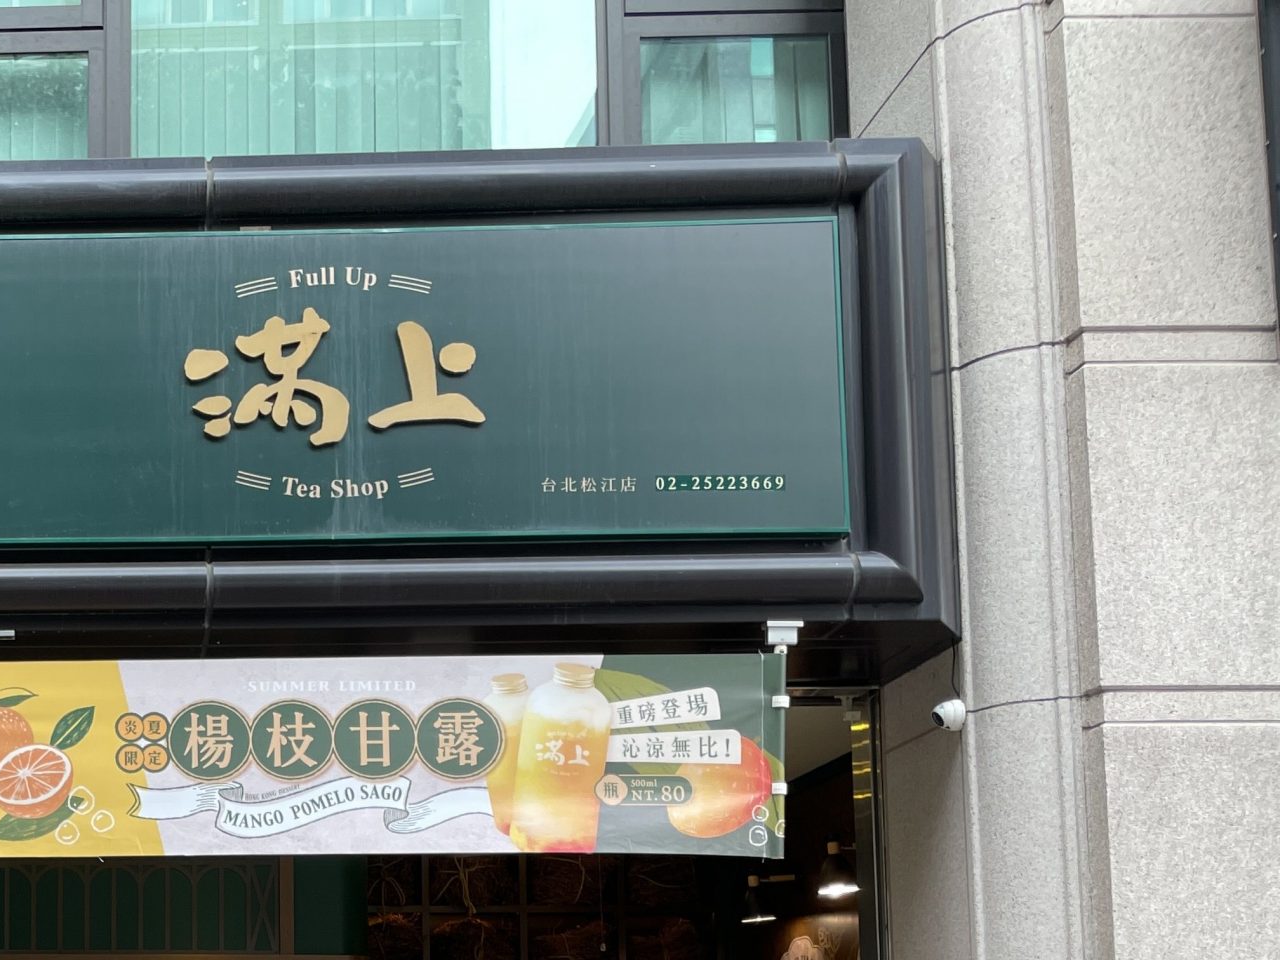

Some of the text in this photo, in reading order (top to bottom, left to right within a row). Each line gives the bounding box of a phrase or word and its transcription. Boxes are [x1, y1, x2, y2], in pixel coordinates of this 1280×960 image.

[289, 267, 378, 290] Full Up
[183, 307, 486, 446] 滿上
[281, 474, 389, 499] Tea Shop
[540, 475, 786, 493] 台北松江店 02-25223669
[248, 679, 416, 693] SUMMER LIMITED
[616, 693, 708, 725] 重磅登場
[123, 719, 162, 736] 炎夏
[183, 710, 485, 769] 楊枝甘露
[124, 751, 162, 766] 限定
[604, 782, 619, 799] 瓶
[631, 779, 657, 787] 500ml
[224, 784, 402, 829] MANGO POMELO SAGO
